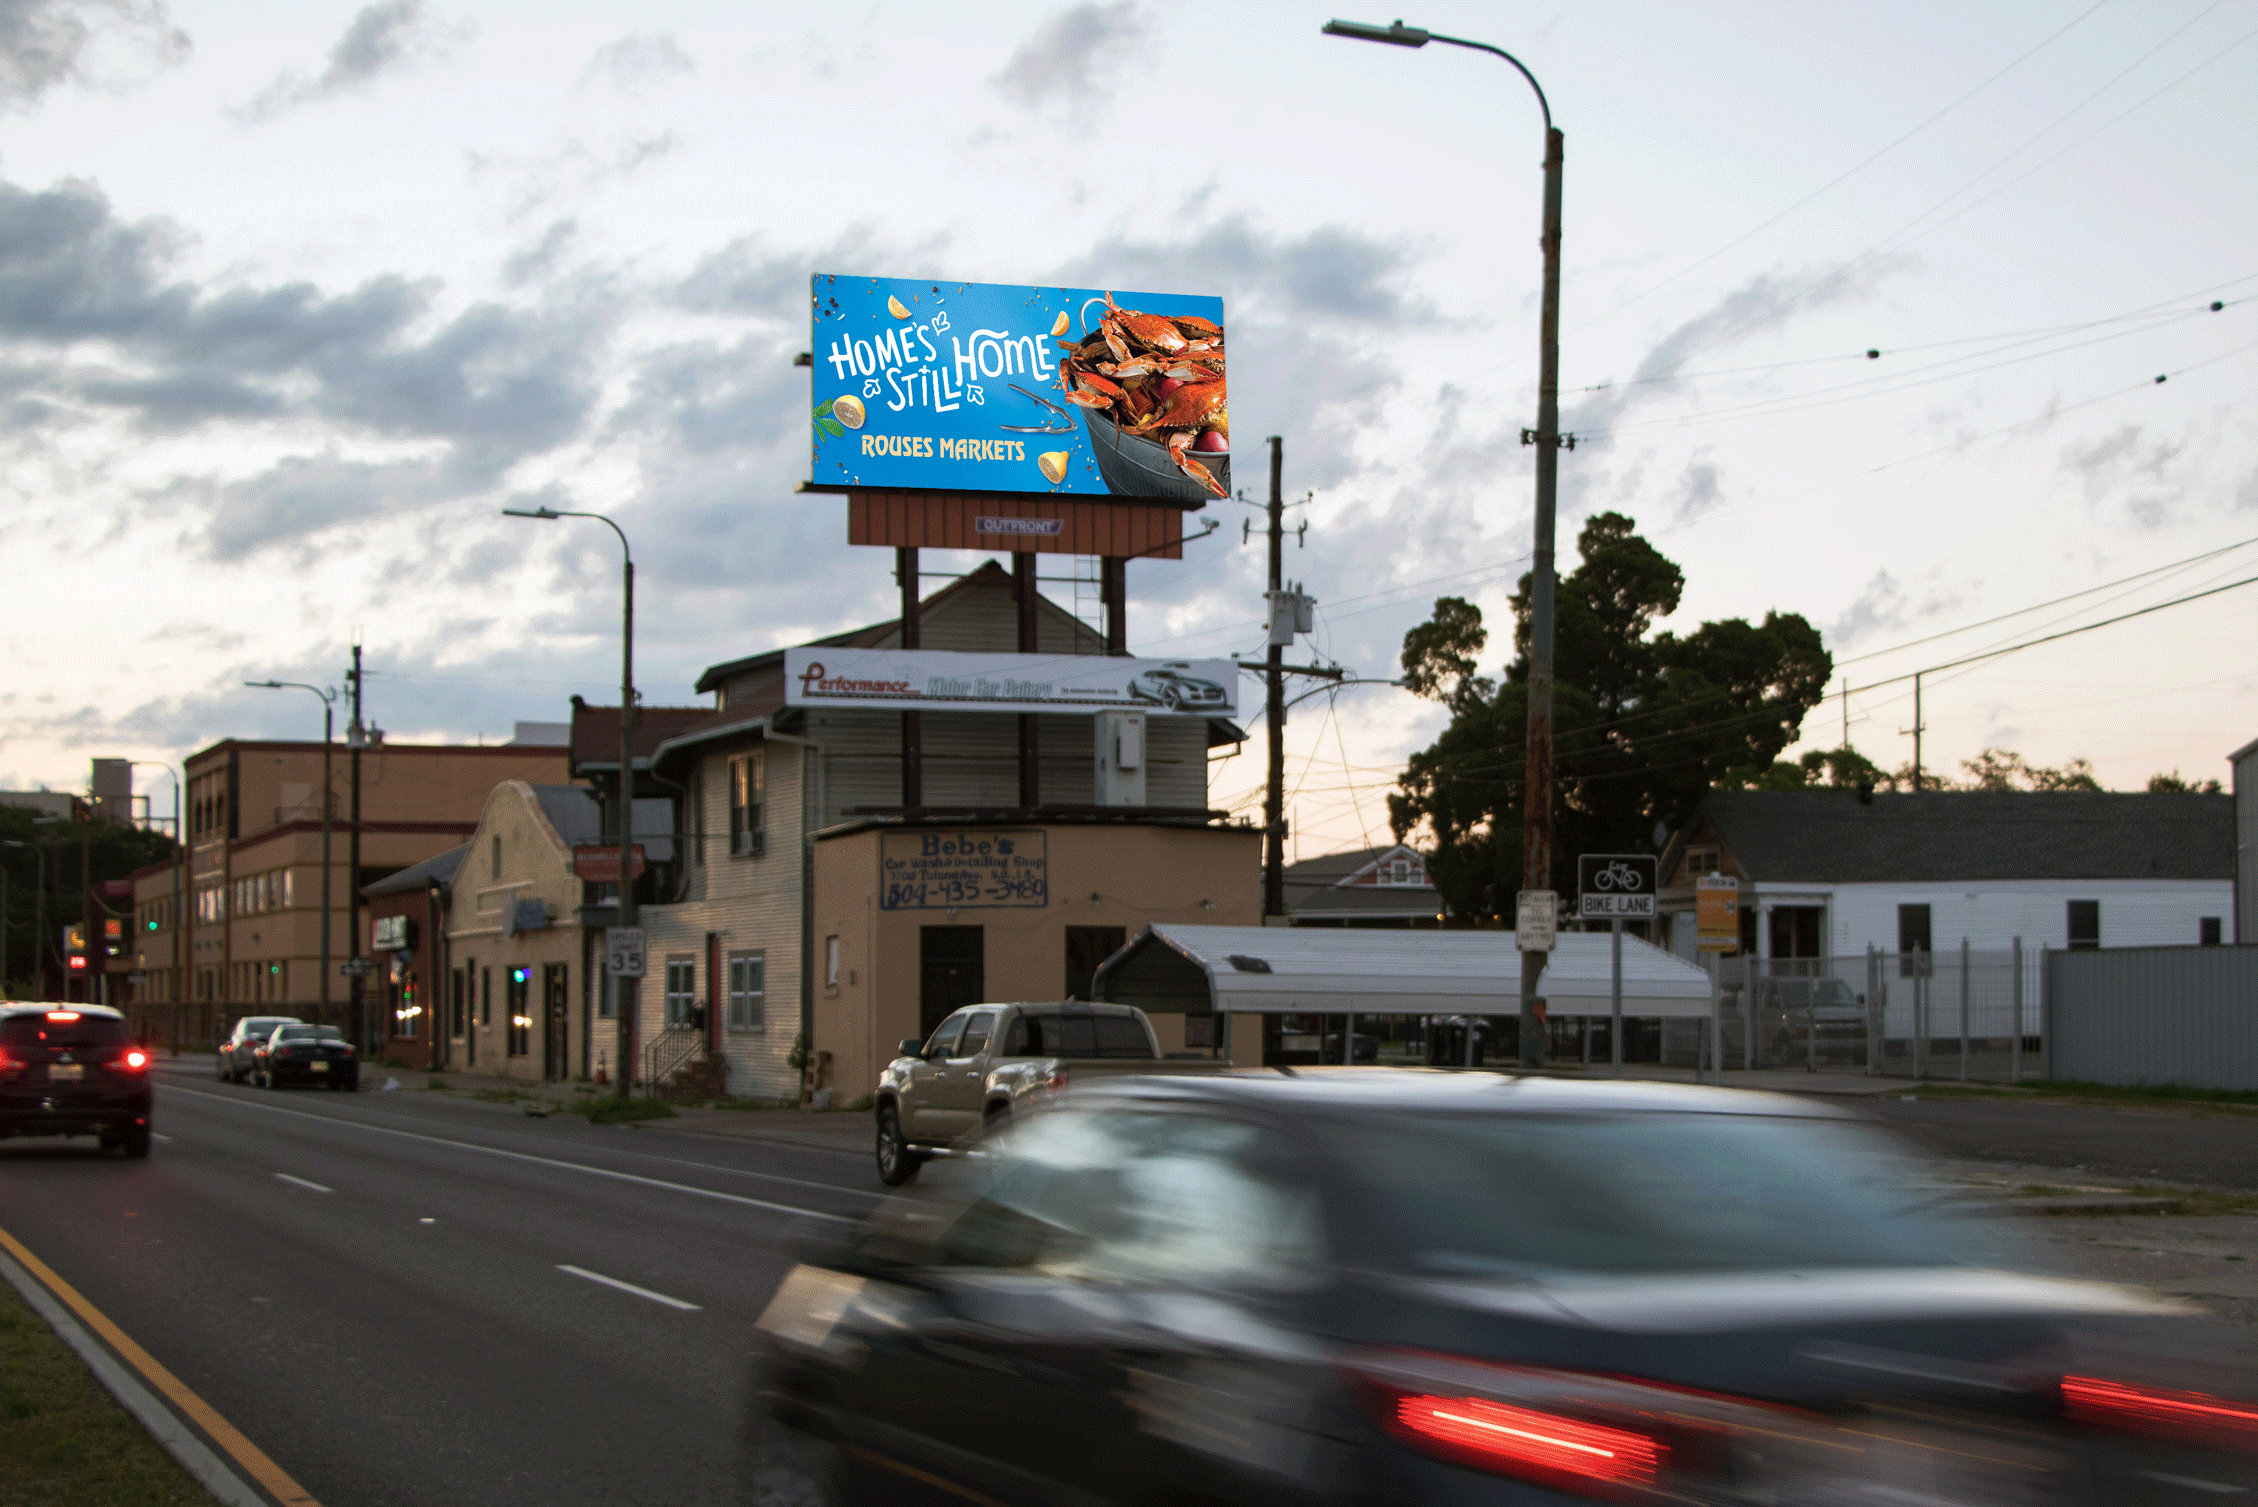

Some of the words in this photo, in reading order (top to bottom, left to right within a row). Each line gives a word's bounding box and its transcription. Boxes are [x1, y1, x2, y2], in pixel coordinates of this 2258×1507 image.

[828, 322, 937, 380] HOME'S
[886, 365, 961, 413] STILL
[951, 329, 1055, 387] HOME
[861, 435, 934, 458] ROUSES
[939, 438, 1026, 462] MARKETS
[983, 518, 1053, 533] OUTFRONT
[798, 662, 912, 698] Performance
[927, 676, 972, 697] Motor
[973, 678, 1002, 698] Car
[1003, 679, 1054, 701] Gallery
[920, 834, 1015, 857] Bebe's
[885, 857, 906, 870] Car
[910, 857, 943, 868] Wash
[1012, 856, 1044, 870] Shop
[1584, 896, 1613, 913] BIKE
[1617, 896, 1652, 913] LANE
[611, 952, 642, 971] 35
